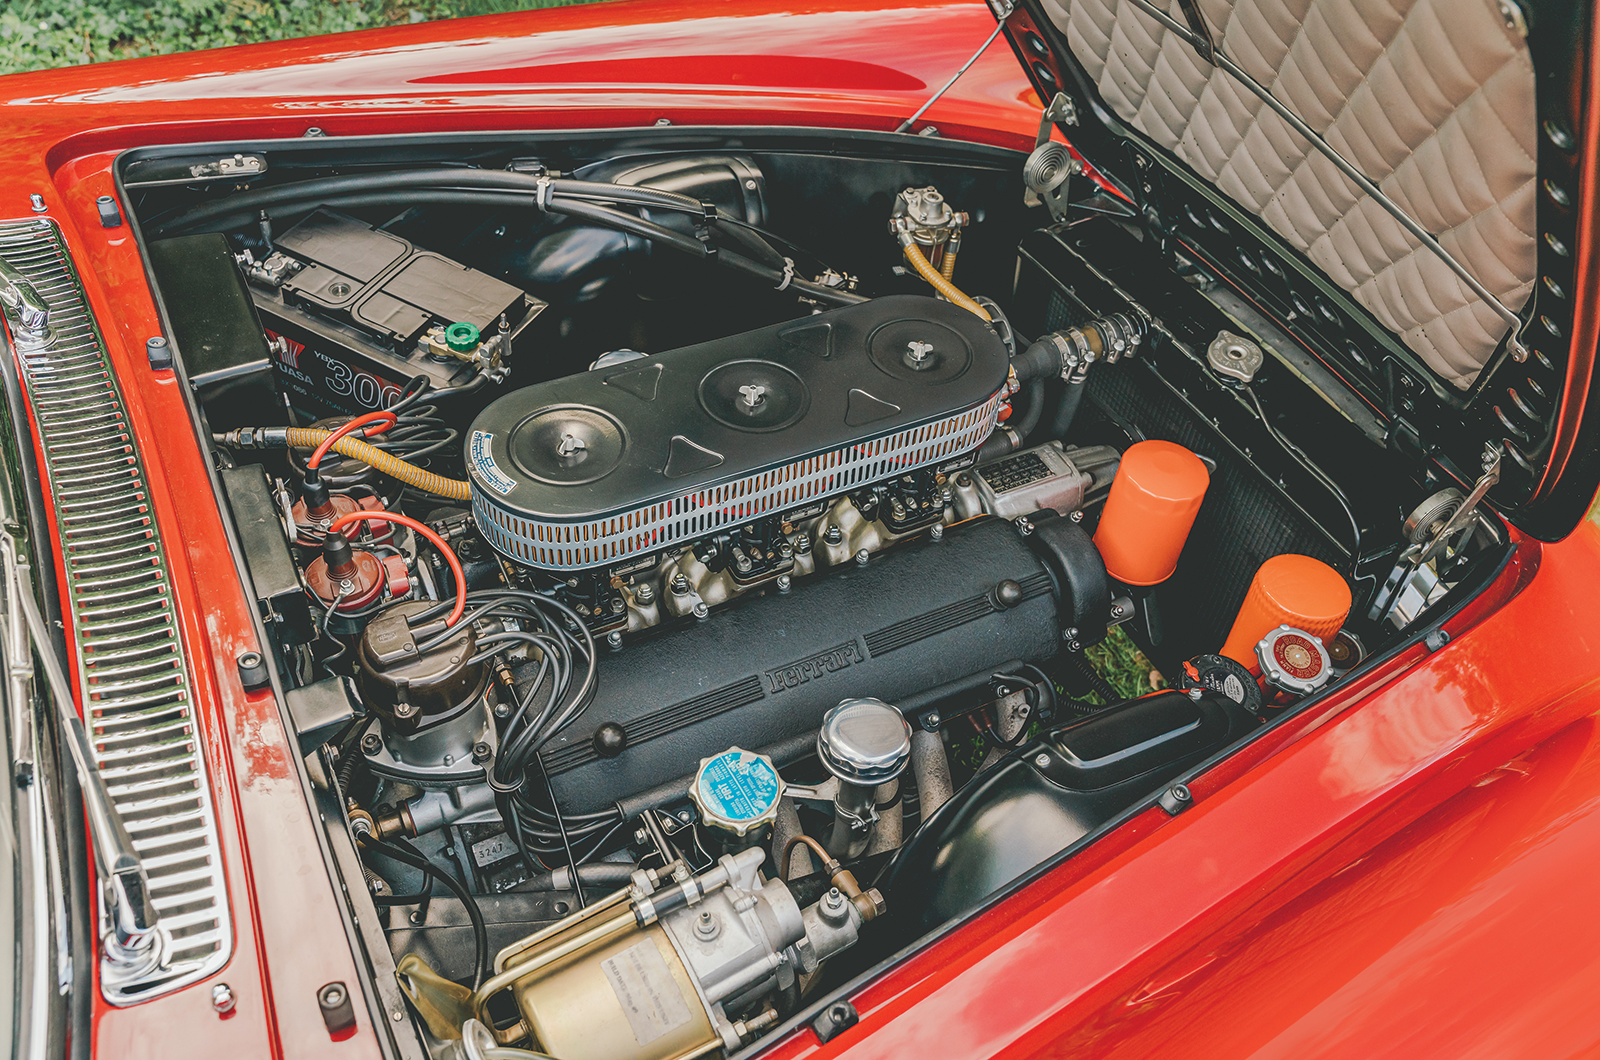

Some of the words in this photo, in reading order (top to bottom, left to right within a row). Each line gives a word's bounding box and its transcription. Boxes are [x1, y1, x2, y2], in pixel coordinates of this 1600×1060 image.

[314, 350, 335, 365] YBX
[275, 361, 314, 386] UASA
[764, 640, 864, 694] Ferrari
[718, 781, 734, 800] FIAT
